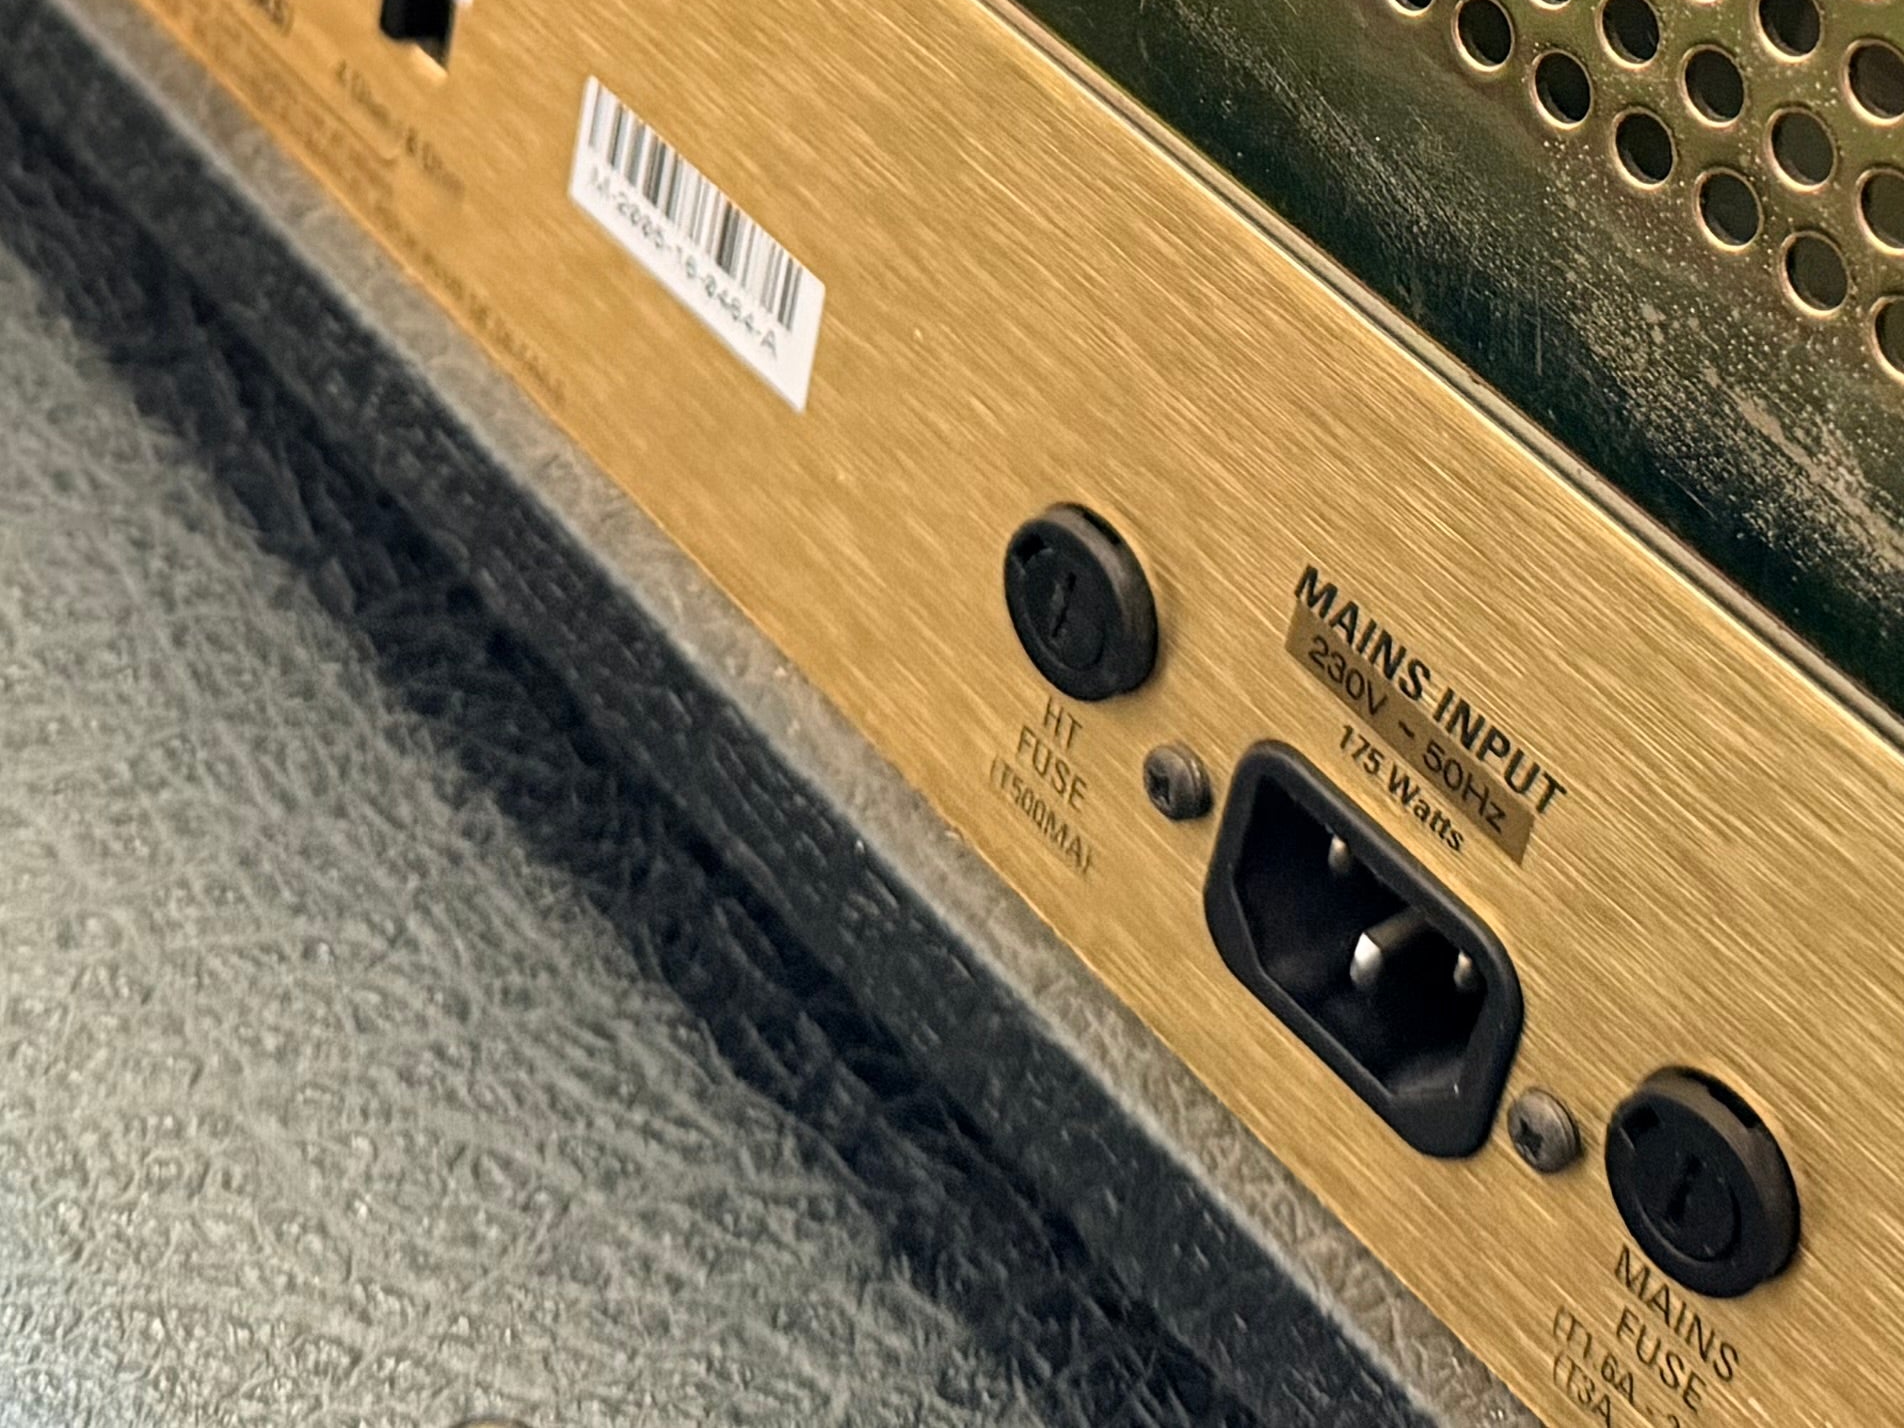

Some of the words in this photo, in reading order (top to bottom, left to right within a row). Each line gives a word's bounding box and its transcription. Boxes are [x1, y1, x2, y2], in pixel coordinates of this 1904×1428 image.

[1043, 695, 1084, 751] HT
[1293, 563, 1431, 701] MAINS
[1432, 686, 1568, 815] INPUT
[1307, 634, 1388, 717] 230V
[1422, 741, 1507, 834] 50Hz
[1017, 724, 1088, 814] FUSE
[1337, 722, 1386, 776] 175
[1388, 761, 1465, 853] Watts
[1615, 1243, 1740, 1382] MAINS
[1616, 1305, 1707, 1415] FUSE
